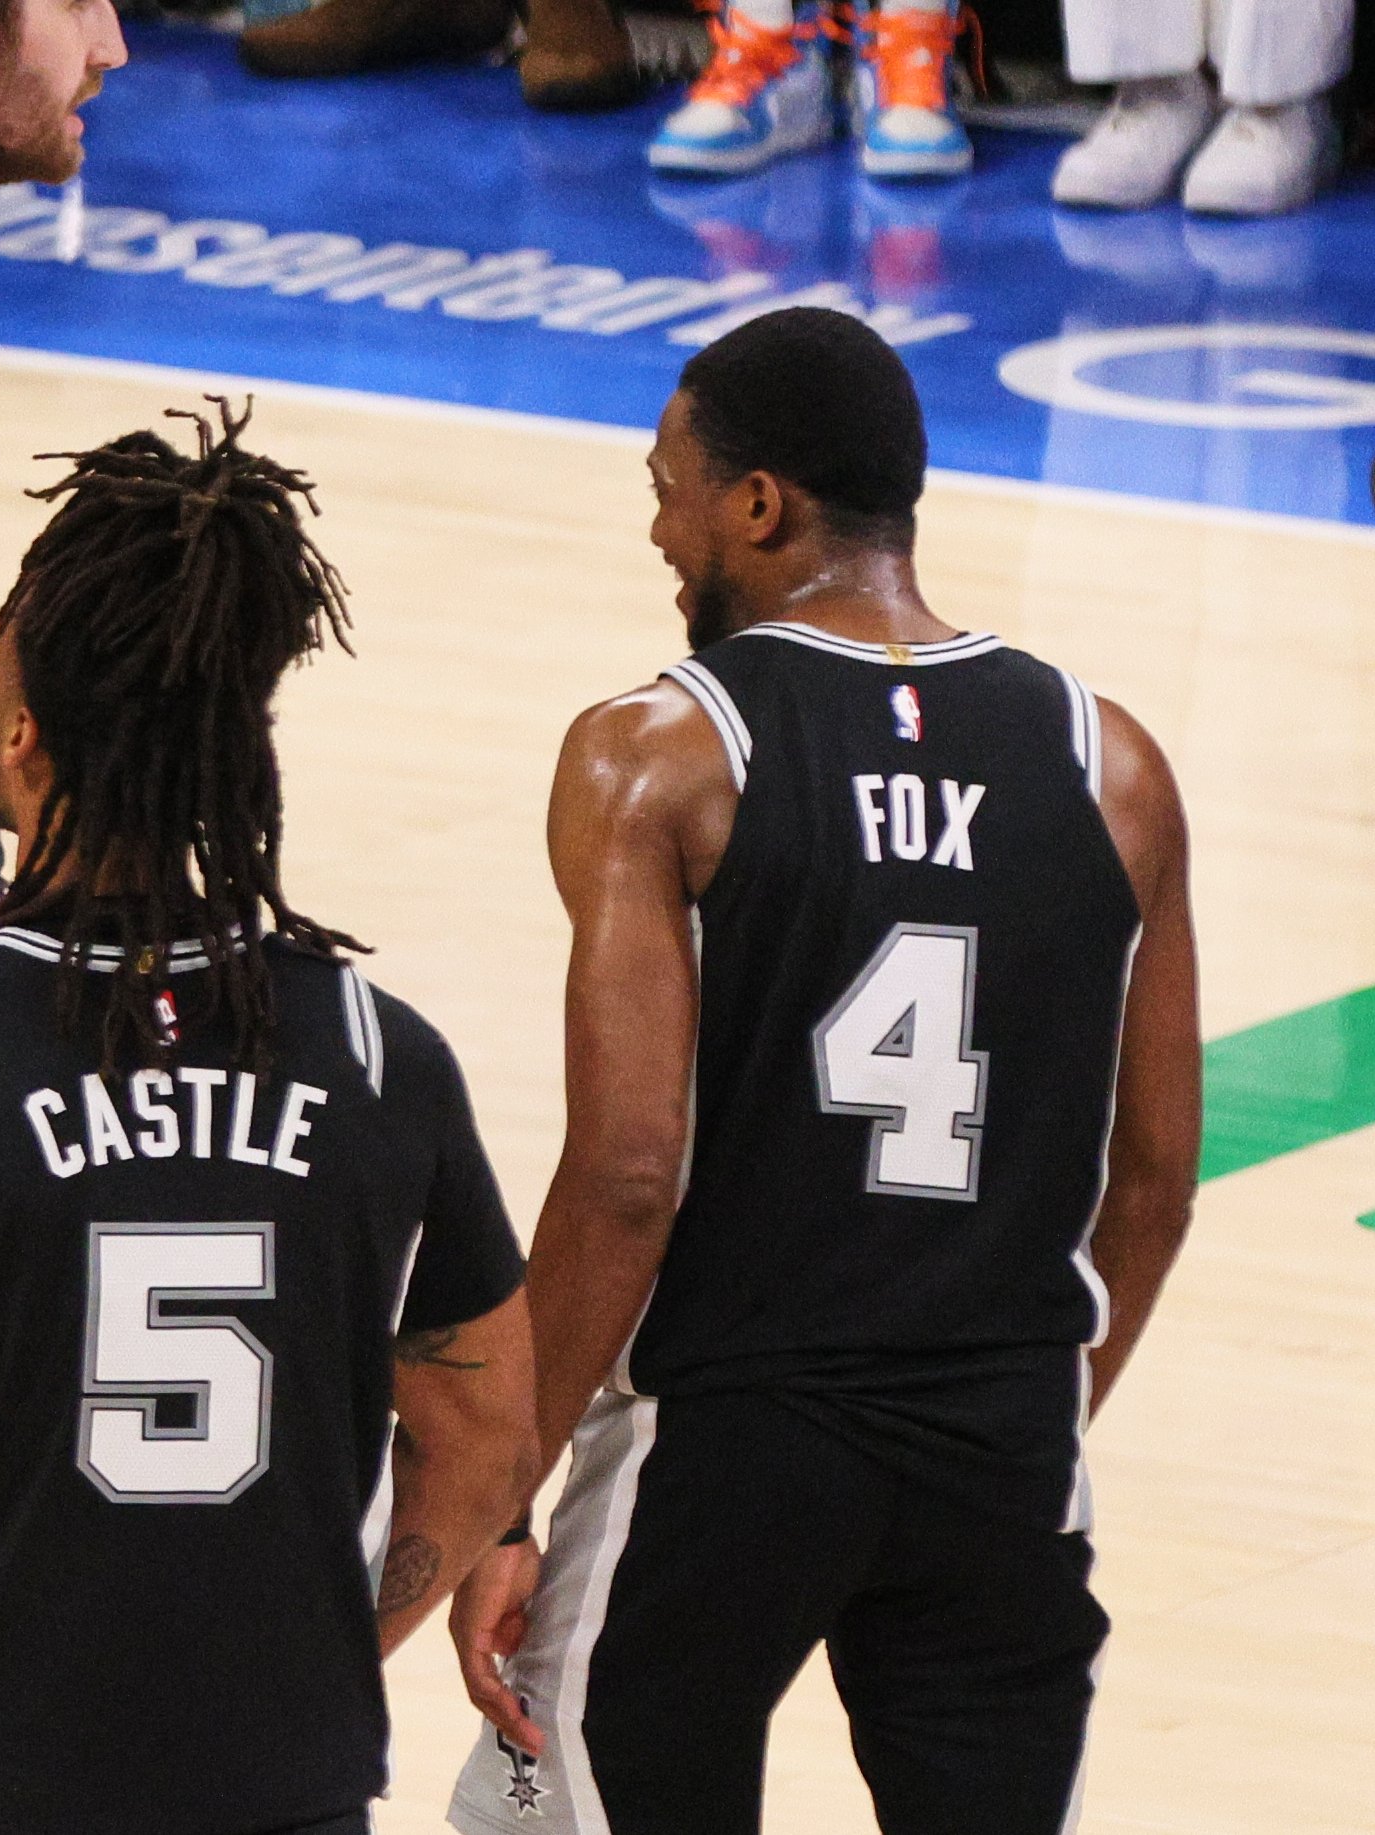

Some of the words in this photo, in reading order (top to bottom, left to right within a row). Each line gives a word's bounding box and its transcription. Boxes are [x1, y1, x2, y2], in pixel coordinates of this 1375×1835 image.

[852, 773, 986, 871] FOX
[24, 1066, 329, 1179] CASTLE
[811, 921, 990, 1202] 4
[76, 1221, 276, 1504] 5
